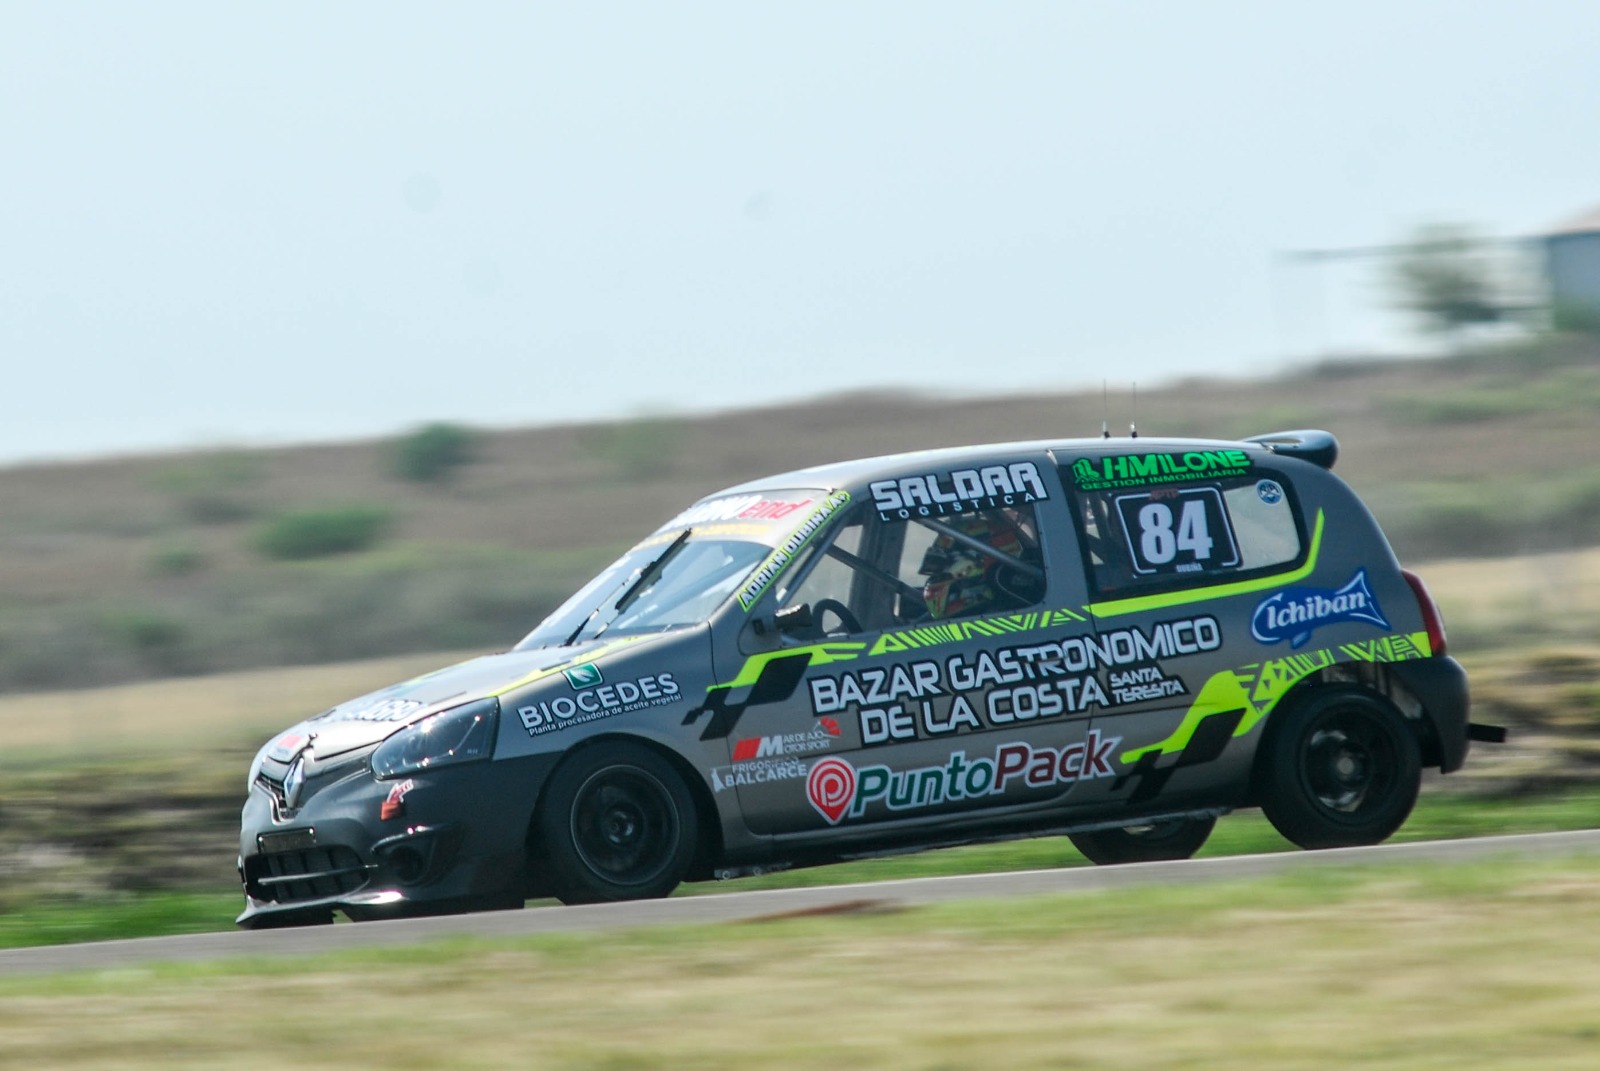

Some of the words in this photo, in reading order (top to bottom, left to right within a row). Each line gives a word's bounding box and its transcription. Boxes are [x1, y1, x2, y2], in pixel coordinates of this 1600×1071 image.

[869, 462, 1048, 511] SALDAR
[1081, 477, 1146, 491] GESTION
[1149, 467, 1247, 483] INMOBILIARIA
[880, 492, 1036, 522] LOGISTICA
[1138, 499, 1214, 565] 84
[739, 551, 789, 608] ADRIAN
[1266, 591, 1367, 630] Ichiban
[811, 661, 943, 713] BAZAR
[948, 616, 1221, 691] GASTRONOMICO
[1110, 666, 1164, 688] SANTA
[517, 673, 680, 729] BIOCEDES
[528, 722, 557, 737] Planta
[558, 710, 611, 730] procesadora
[611, 706, 623, 716] de
[624, 701, 650, 712] aceite
[650, 693, 682, 706] vegetal
[860, 705, 915, 745] DE
[922, 696, 980, 733] LA
[988, 675, 1110, 724] COSTA
[1112, 679, 1186, 705] TERESITA
[725, 763, 808, 788] BALCARCE
[849, 731, 1120, 817] PuntoPack
